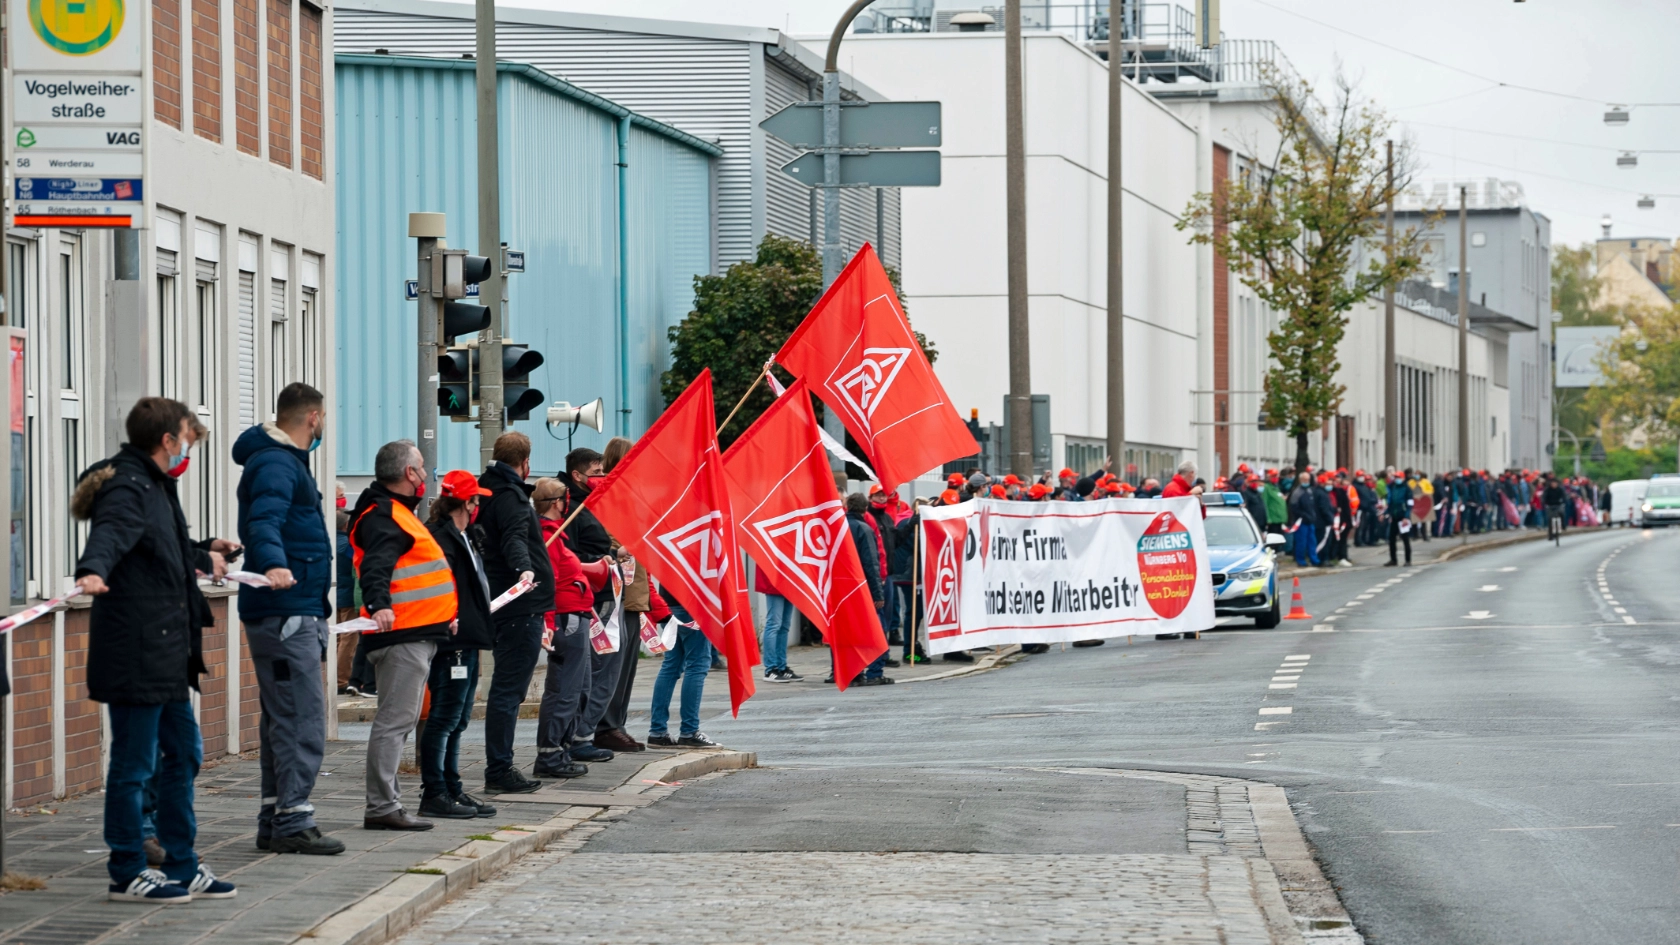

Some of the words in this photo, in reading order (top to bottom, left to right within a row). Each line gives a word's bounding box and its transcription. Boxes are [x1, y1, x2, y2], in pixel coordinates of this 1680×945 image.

[25, 80, 135, 98] Vogelweiher-
[51, 103, 106, 118] straße
[106, 132, 140, 145] VAG
[17, 158, 31, 168] 58
[49, 159, 94, 168] Werderau
[48, 191, 115, 200] Hauptbahnhof
[17, 204, 31, 214] 65
[1140, 534, 1188, 551] SIEMENS
[1009, 582, 1045, 615] seine
[1051, 576, 1139, 614] Mitarbeitr
